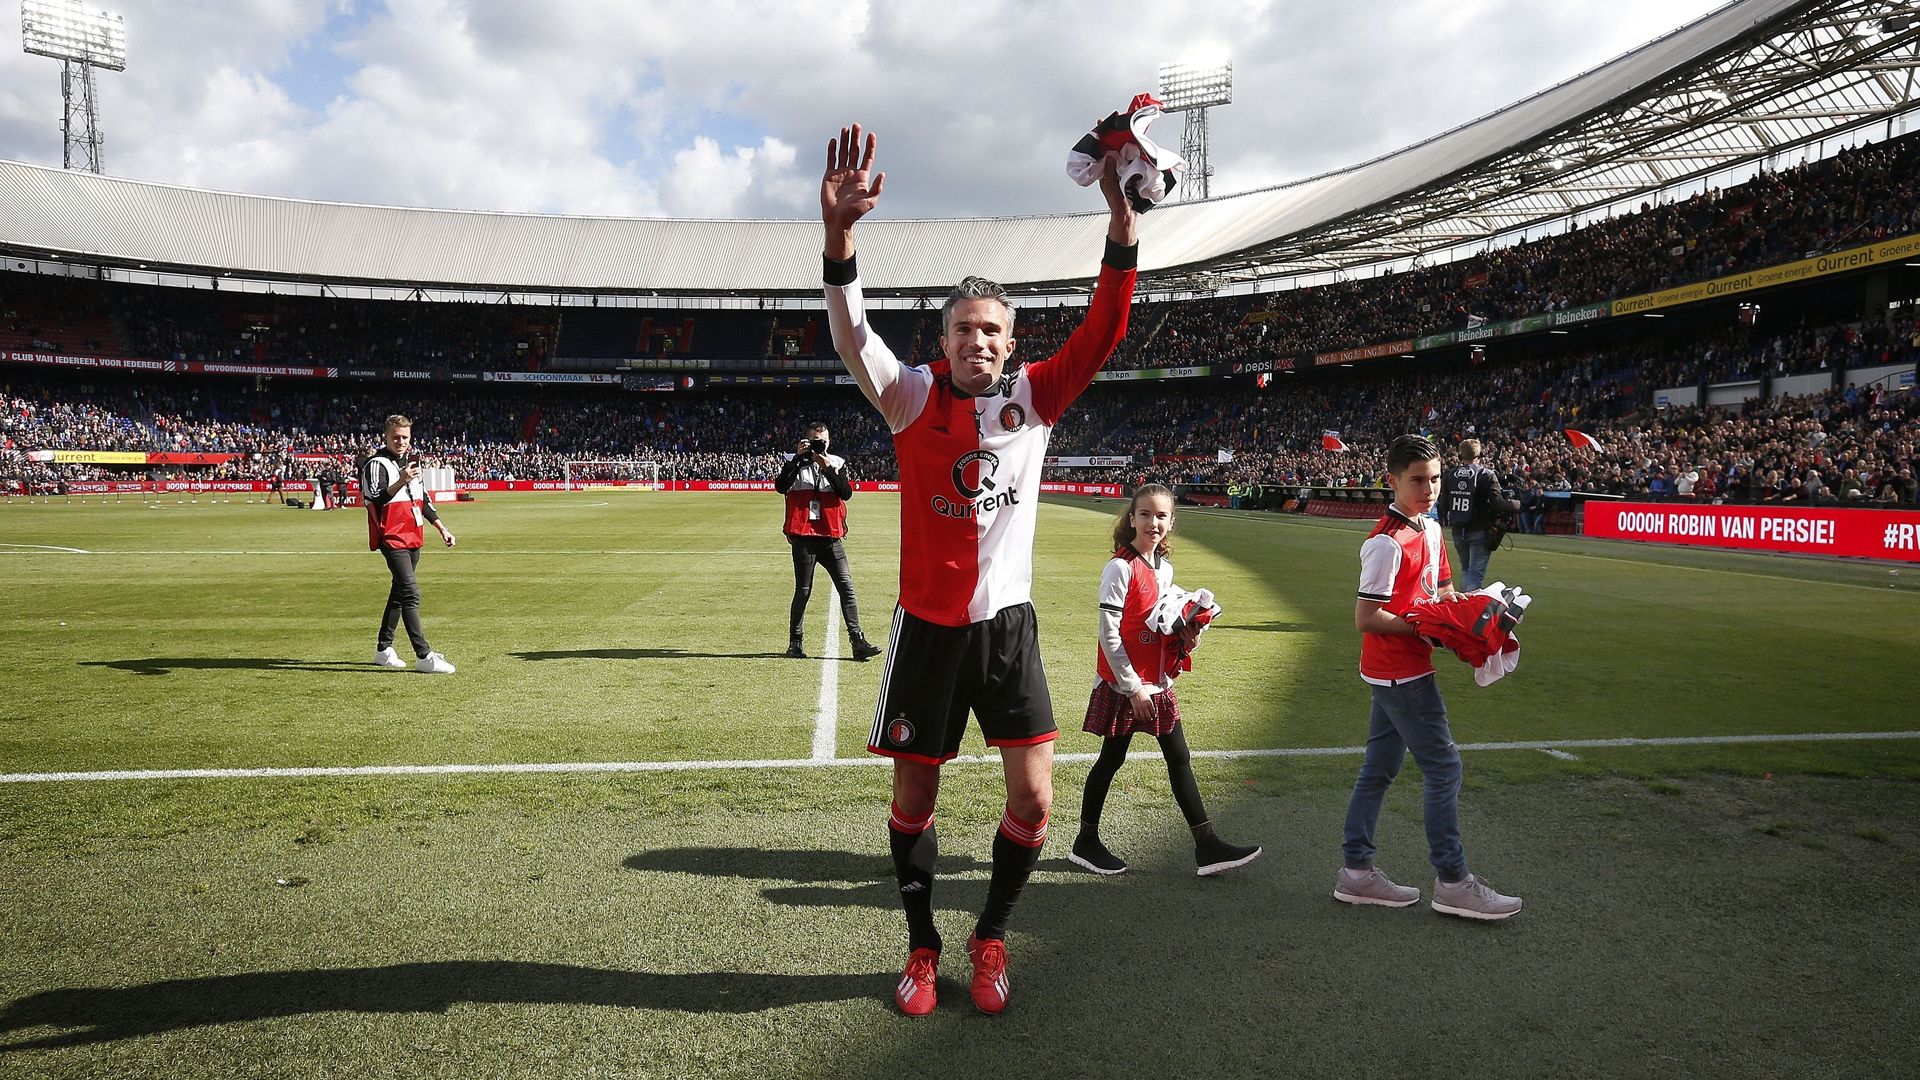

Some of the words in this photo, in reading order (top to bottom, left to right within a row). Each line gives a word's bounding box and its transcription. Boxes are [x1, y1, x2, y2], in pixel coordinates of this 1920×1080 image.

[1615, 296, 1653, 313] Qurrent
[1657, 294, 1680, 303] Groene
[1680, 289, 1703, 299] energie
[1707, 275, 1752, 295] Qurrent
[1757, 271, 1783, 284] Groene
[1784, 264, 1812, 277] energie
[1816, 248, 1874, 273] Qurrent
[1879, 243, 1911, 258] Groene
[1555, 308, 1597, 325] Heineken
[1458, 327, 1493, 342] Heineken
[1364, 347, 1377, 357] ING
[1389, 343, 1402, 354] ING
[11, 352, 34, 361] CLUB
[36, 354, 53, 363] VAN
[55, 356, 98, 367] IEDEREEN,
[99, 358, 121, 367] VOOR
[123, 360, 162, 369] IEDEREEN
[1316, 355, 1330, 364] ING
[1340, 352, 1353, 360] ING
[204, 364, 287, 375] ONVOORWAARDELIJKE
[287, 367, 314, 376] TROUW
[1245, 359, 1273, 373] pepsi
[393, 371, 431, 379] HELMINK
[497, 373, 512, 381] VLS
[523, 373, 584, 382] SCHOONMAAK
[589, 374, 604, 382] VLS
[1115, 370, 1130, 379] kpn
[1179, 368, 1193, 377] kpn
[931, 486, 1020, 518] Qurrent
[1452, 497, 1470, 511] HB
[1618, 510, 1665, 534] OOOOH
[1668, 513, 1715, 537] ROBIN
[1721, 515, 1755, 539] VAN
[1760, 517, 1835, 544] PERSIE!
